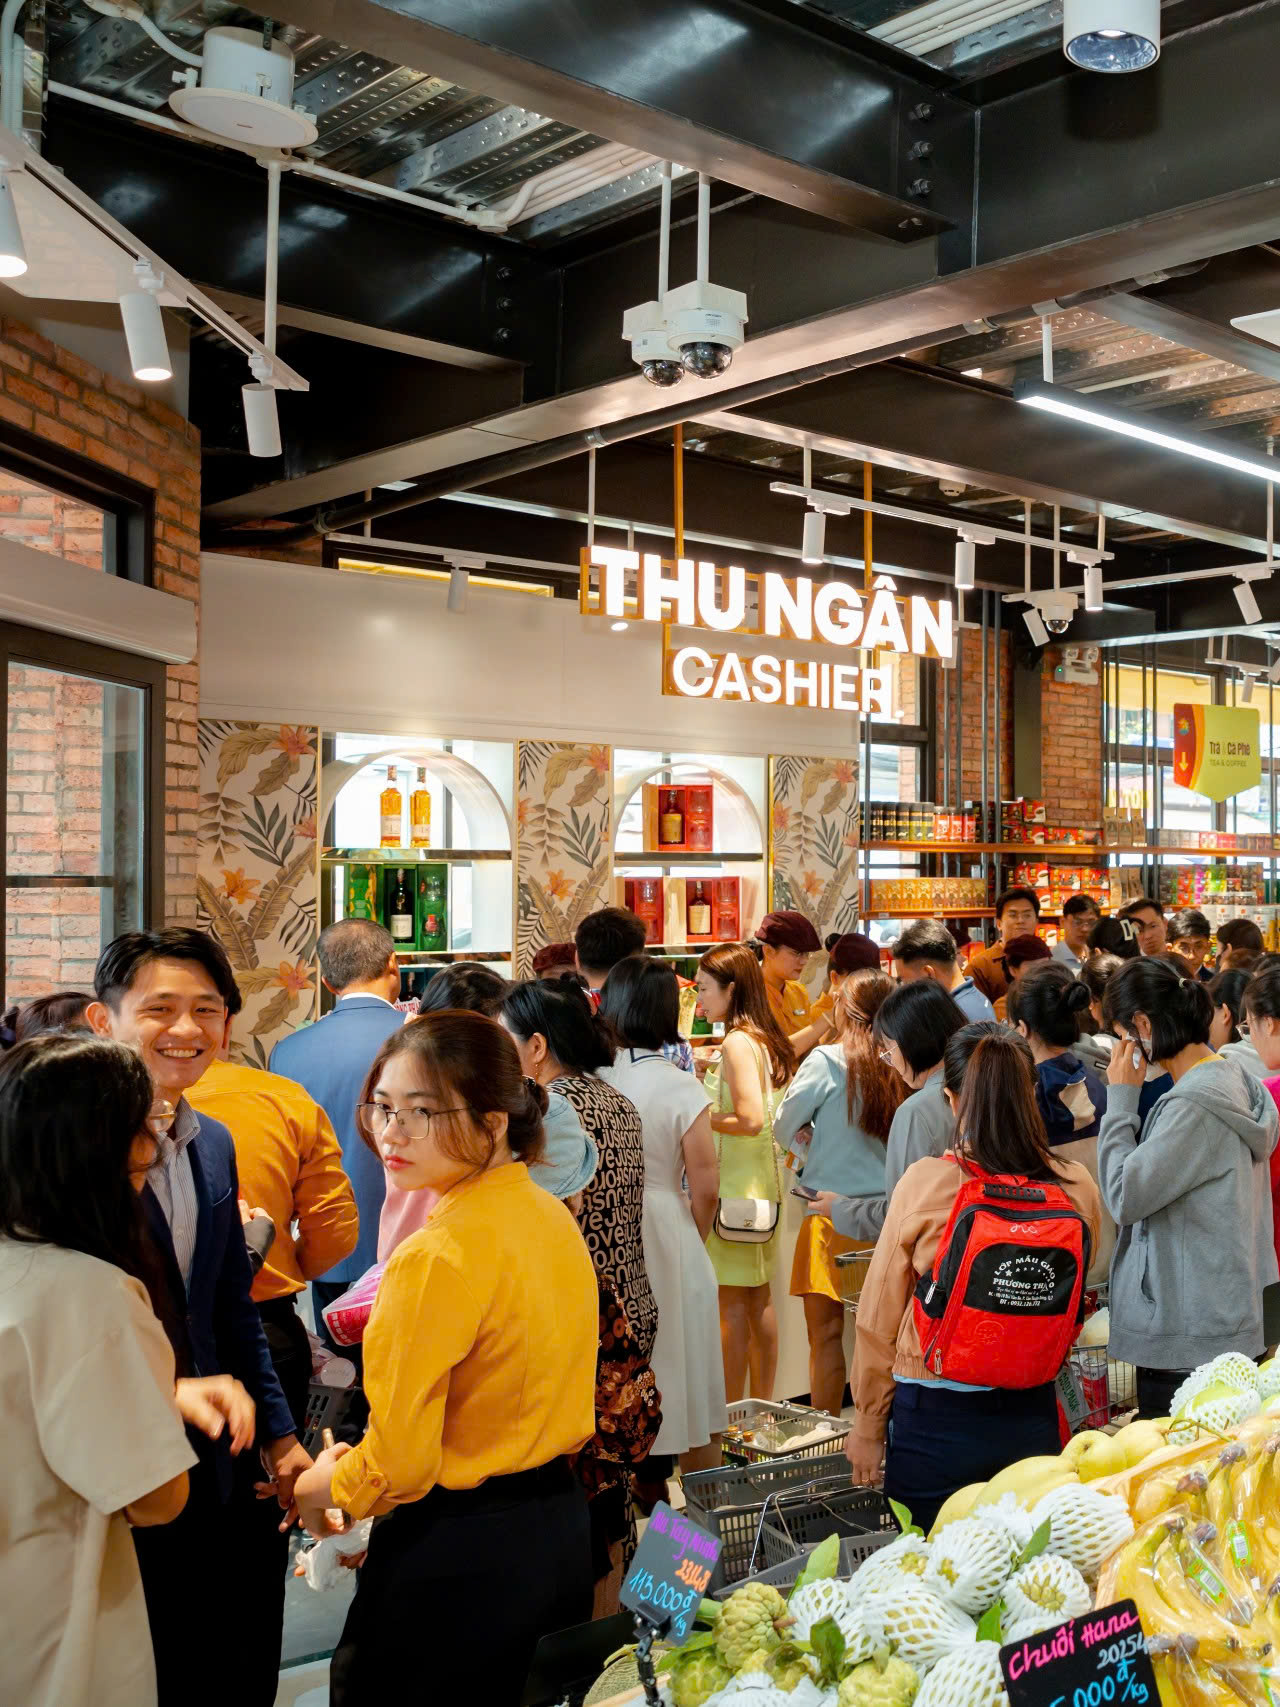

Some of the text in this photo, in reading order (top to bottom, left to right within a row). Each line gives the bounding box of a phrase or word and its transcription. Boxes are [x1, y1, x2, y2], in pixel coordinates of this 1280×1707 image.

[590, 545, 953, 659] THU NGÂN
[673, 646, 888, 713] CASHIER
